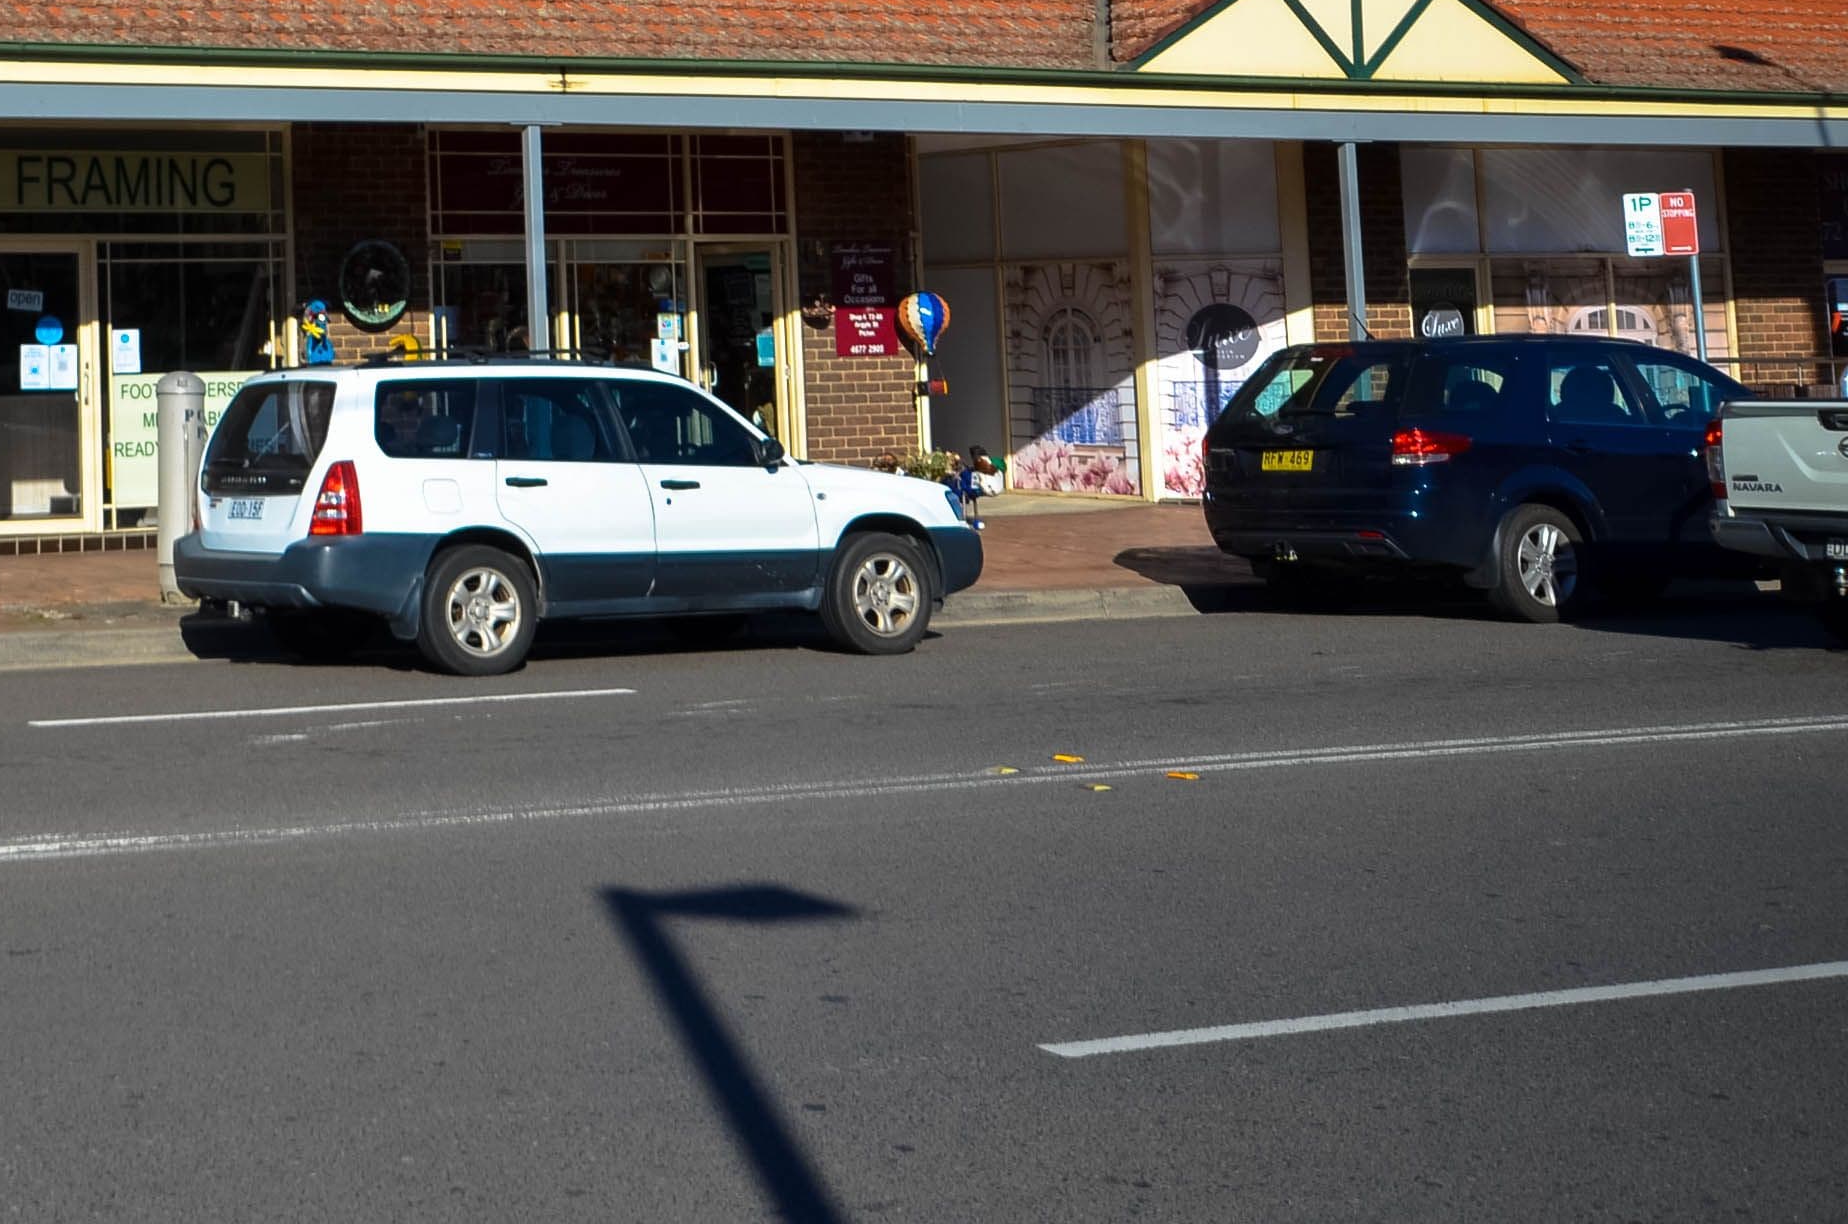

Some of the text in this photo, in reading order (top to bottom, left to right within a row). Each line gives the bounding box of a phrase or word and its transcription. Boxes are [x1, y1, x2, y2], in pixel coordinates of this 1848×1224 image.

[17, 155, 235, 206] FRAMING
[1632, 197, 1652, 212] 1P
[1669, 197, 1684, 208] NO
[1662, 209, 1694, 218] STOPPING
[10, 292, 41, 306] open
[1733, 482, 1783, 493] NAVARA
